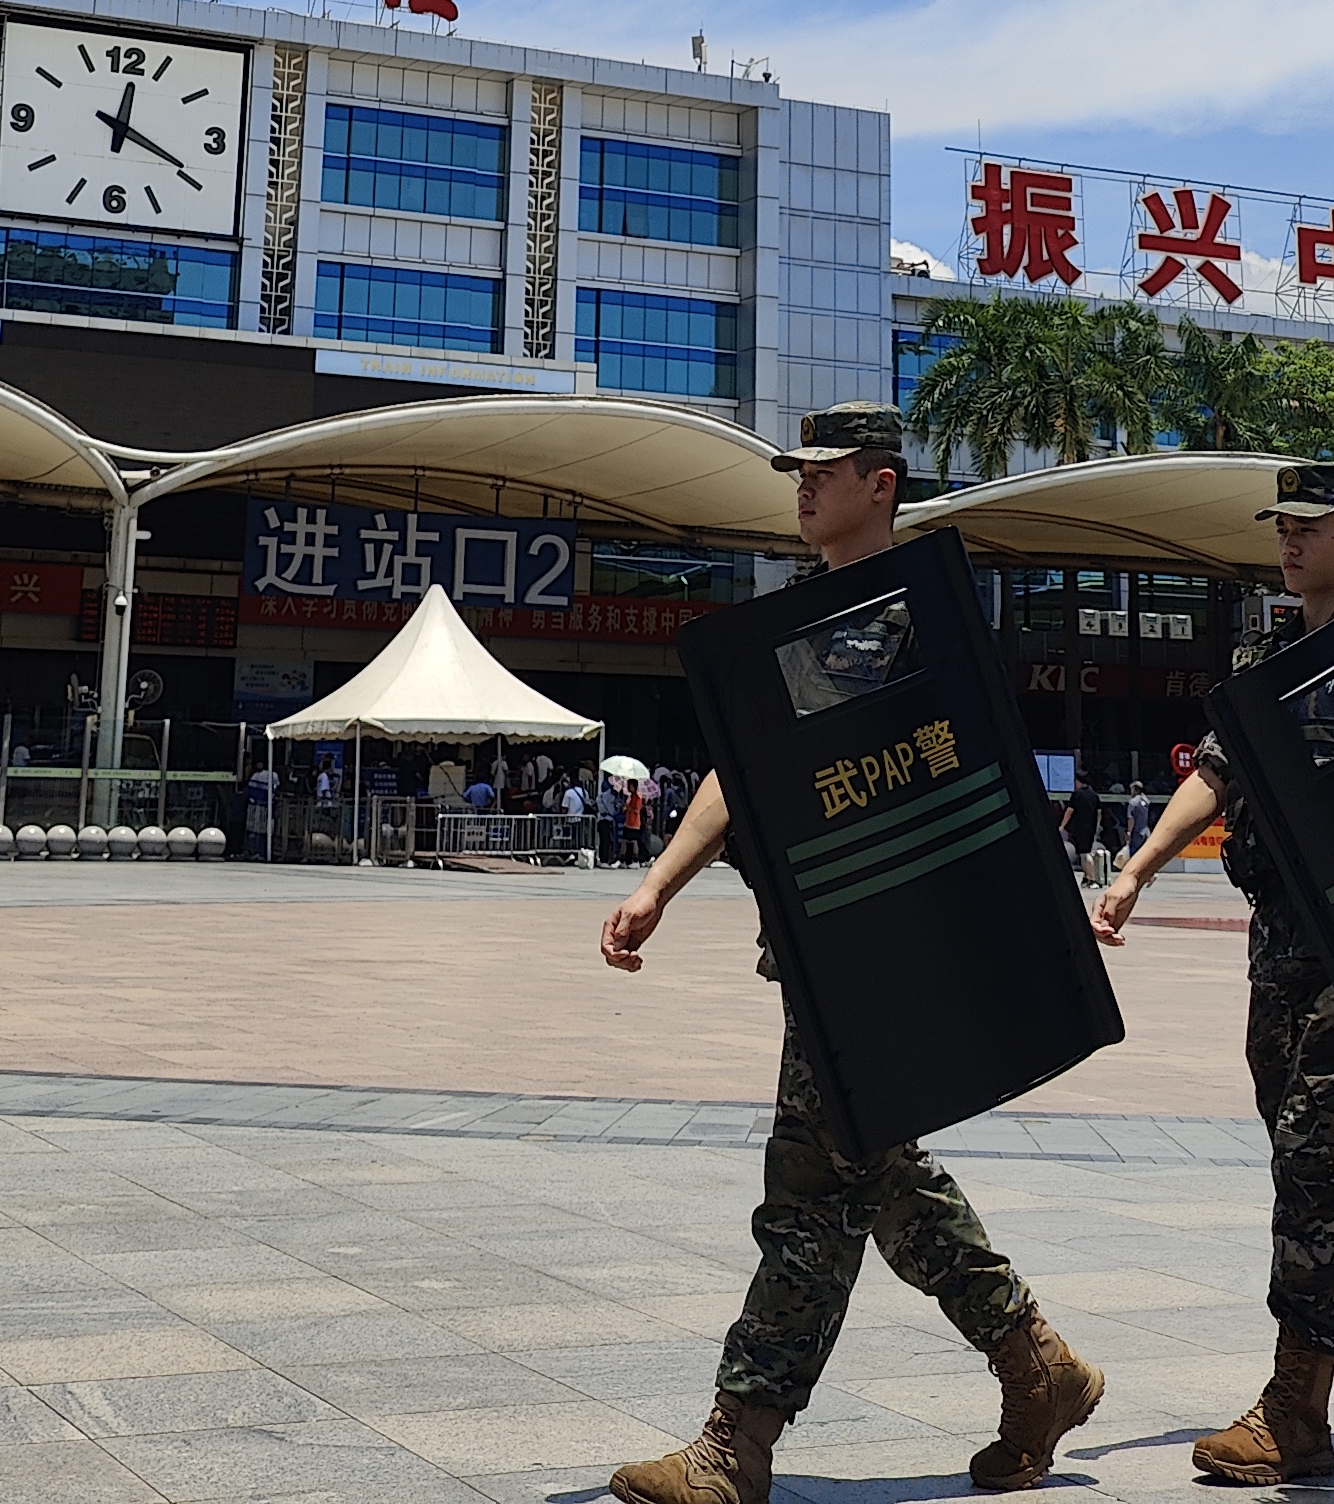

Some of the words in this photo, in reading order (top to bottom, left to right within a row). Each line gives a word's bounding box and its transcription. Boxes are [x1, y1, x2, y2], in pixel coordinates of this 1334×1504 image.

[105, 45, 145, 76] 12
[9, 103, 36, 133] 9
[203, 126, 227, 155] 3
[101, 185, 127, 214] 6
[360, 358, 412, 375] TRAIN
[419, 360, 536, 386] INFORMATION
[254, 506, 570, 606] 进站口2
